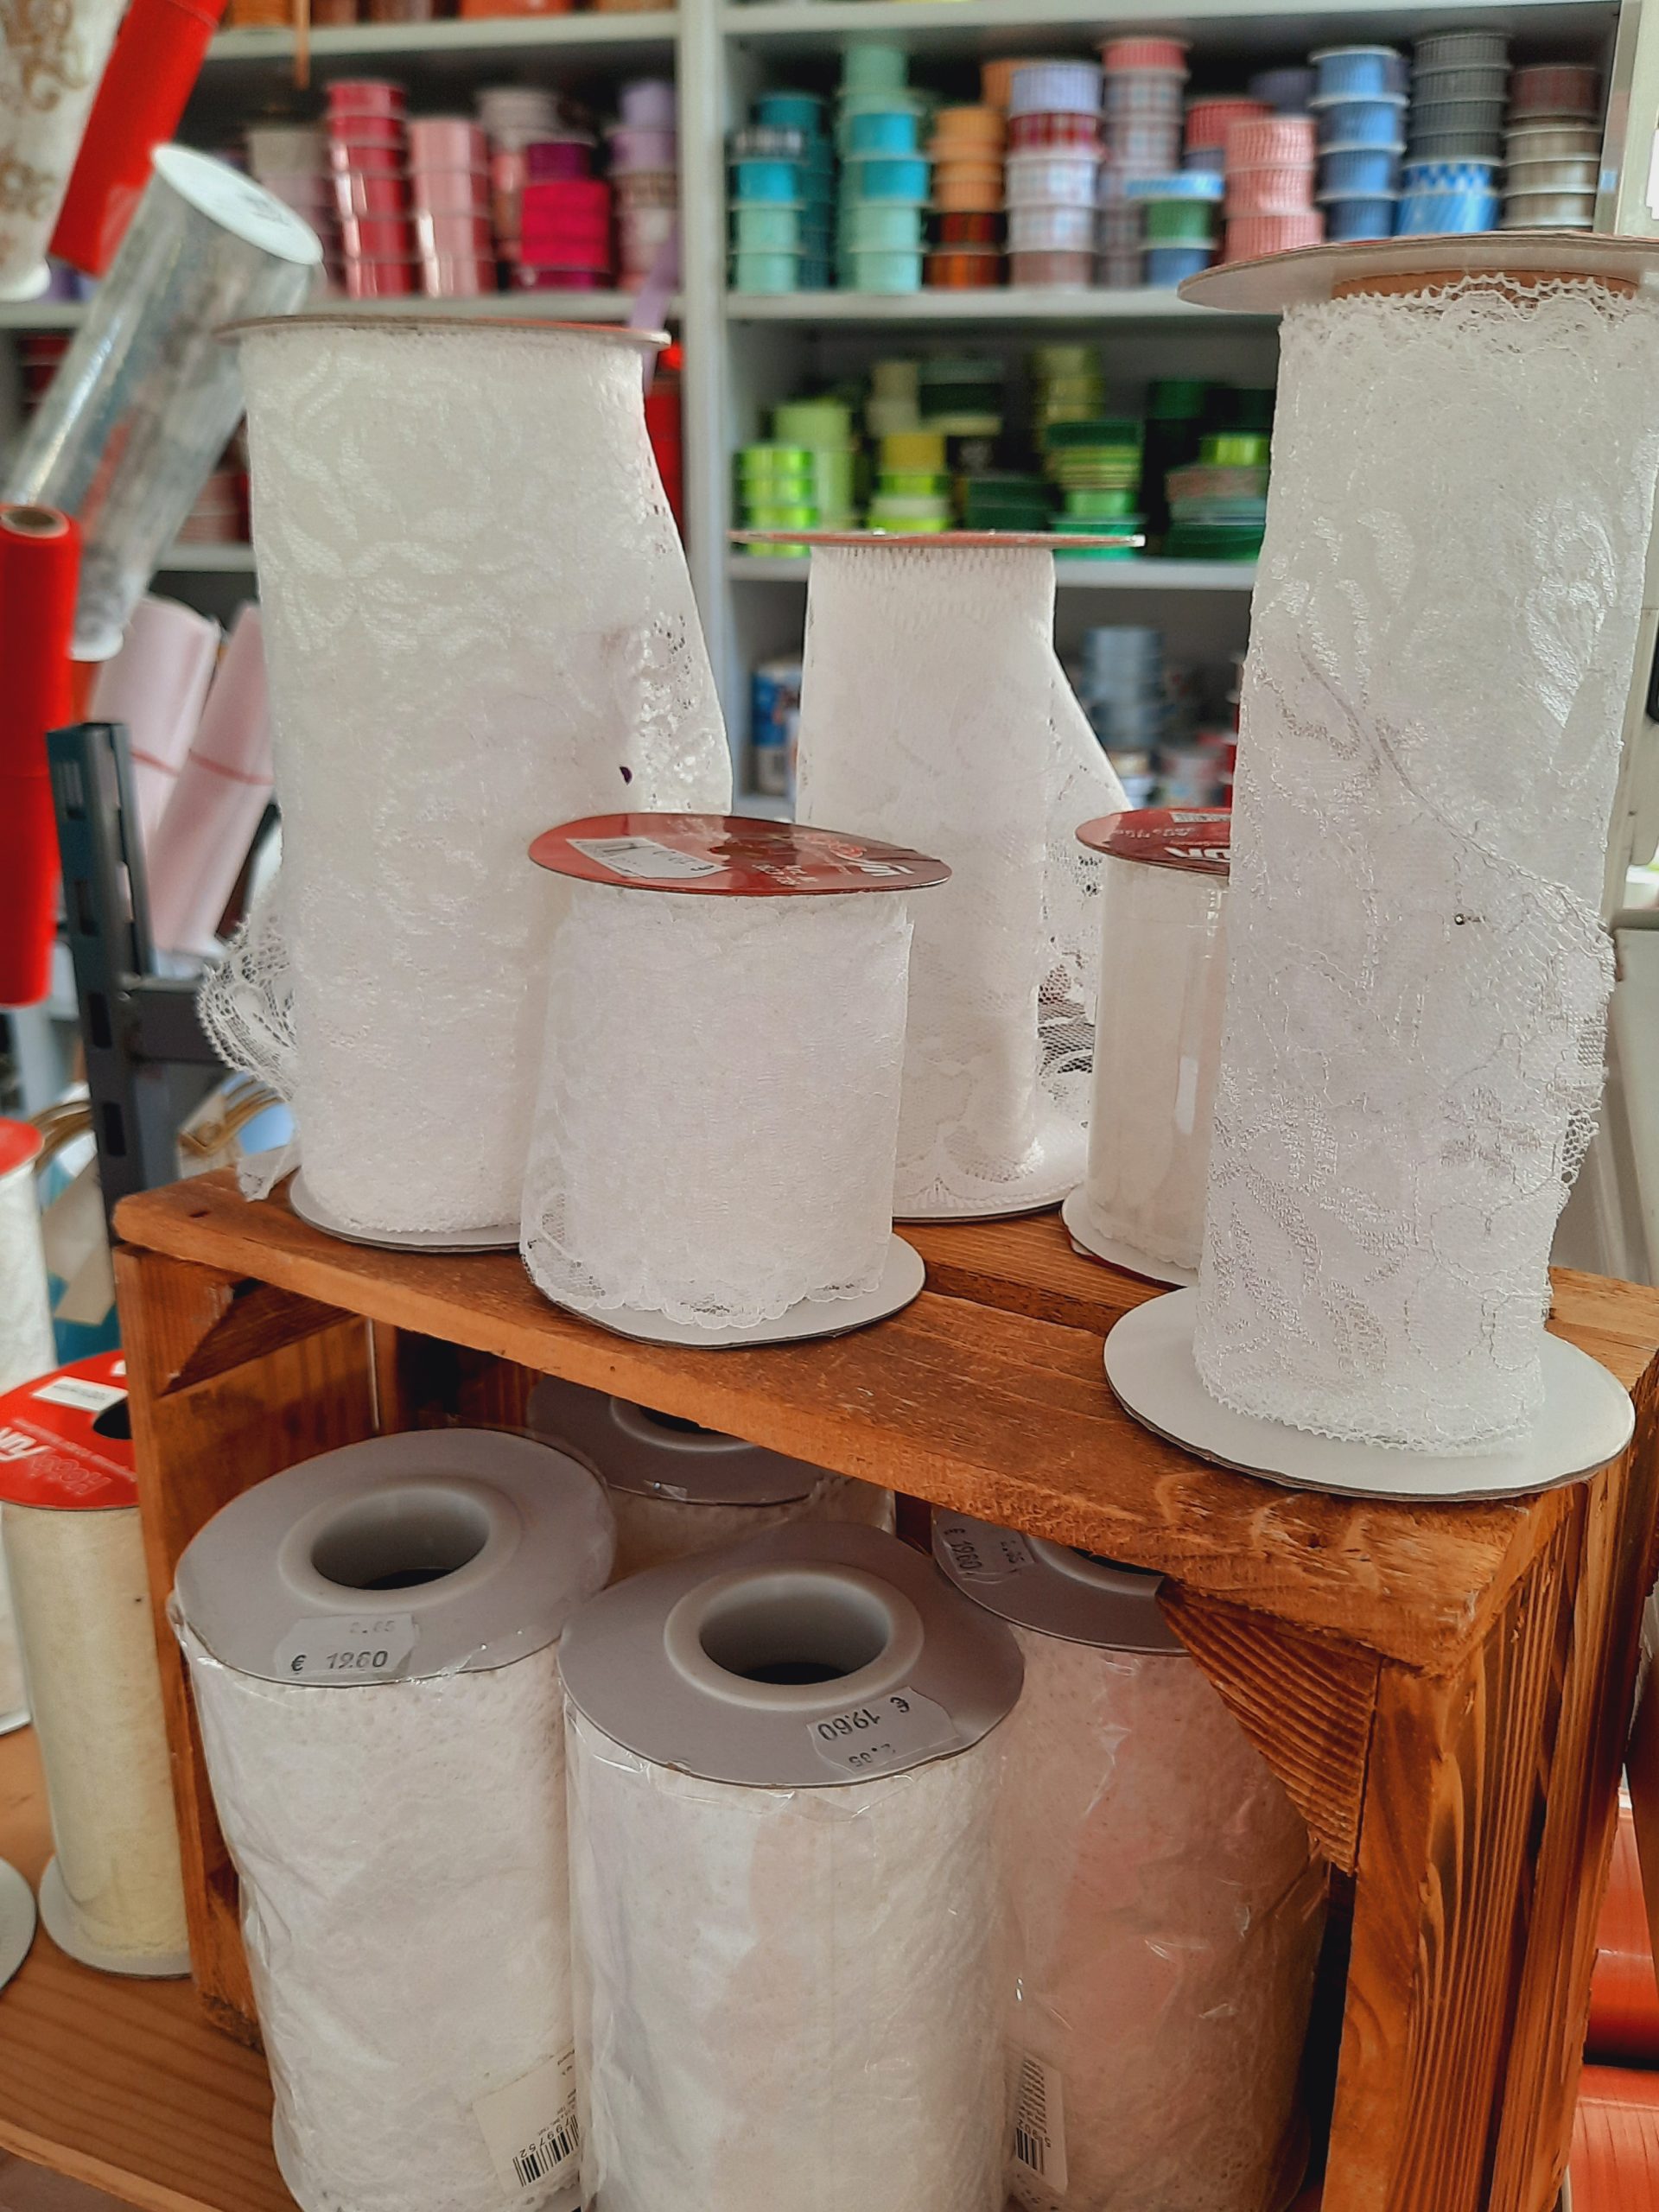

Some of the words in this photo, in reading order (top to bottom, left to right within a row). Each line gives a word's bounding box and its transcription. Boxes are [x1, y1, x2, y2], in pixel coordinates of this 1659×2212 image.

[290, 1654, 307, 1672] €
[890, 1696, 910, 1713] €
[817, 1708, 880, 1741] 19.60
